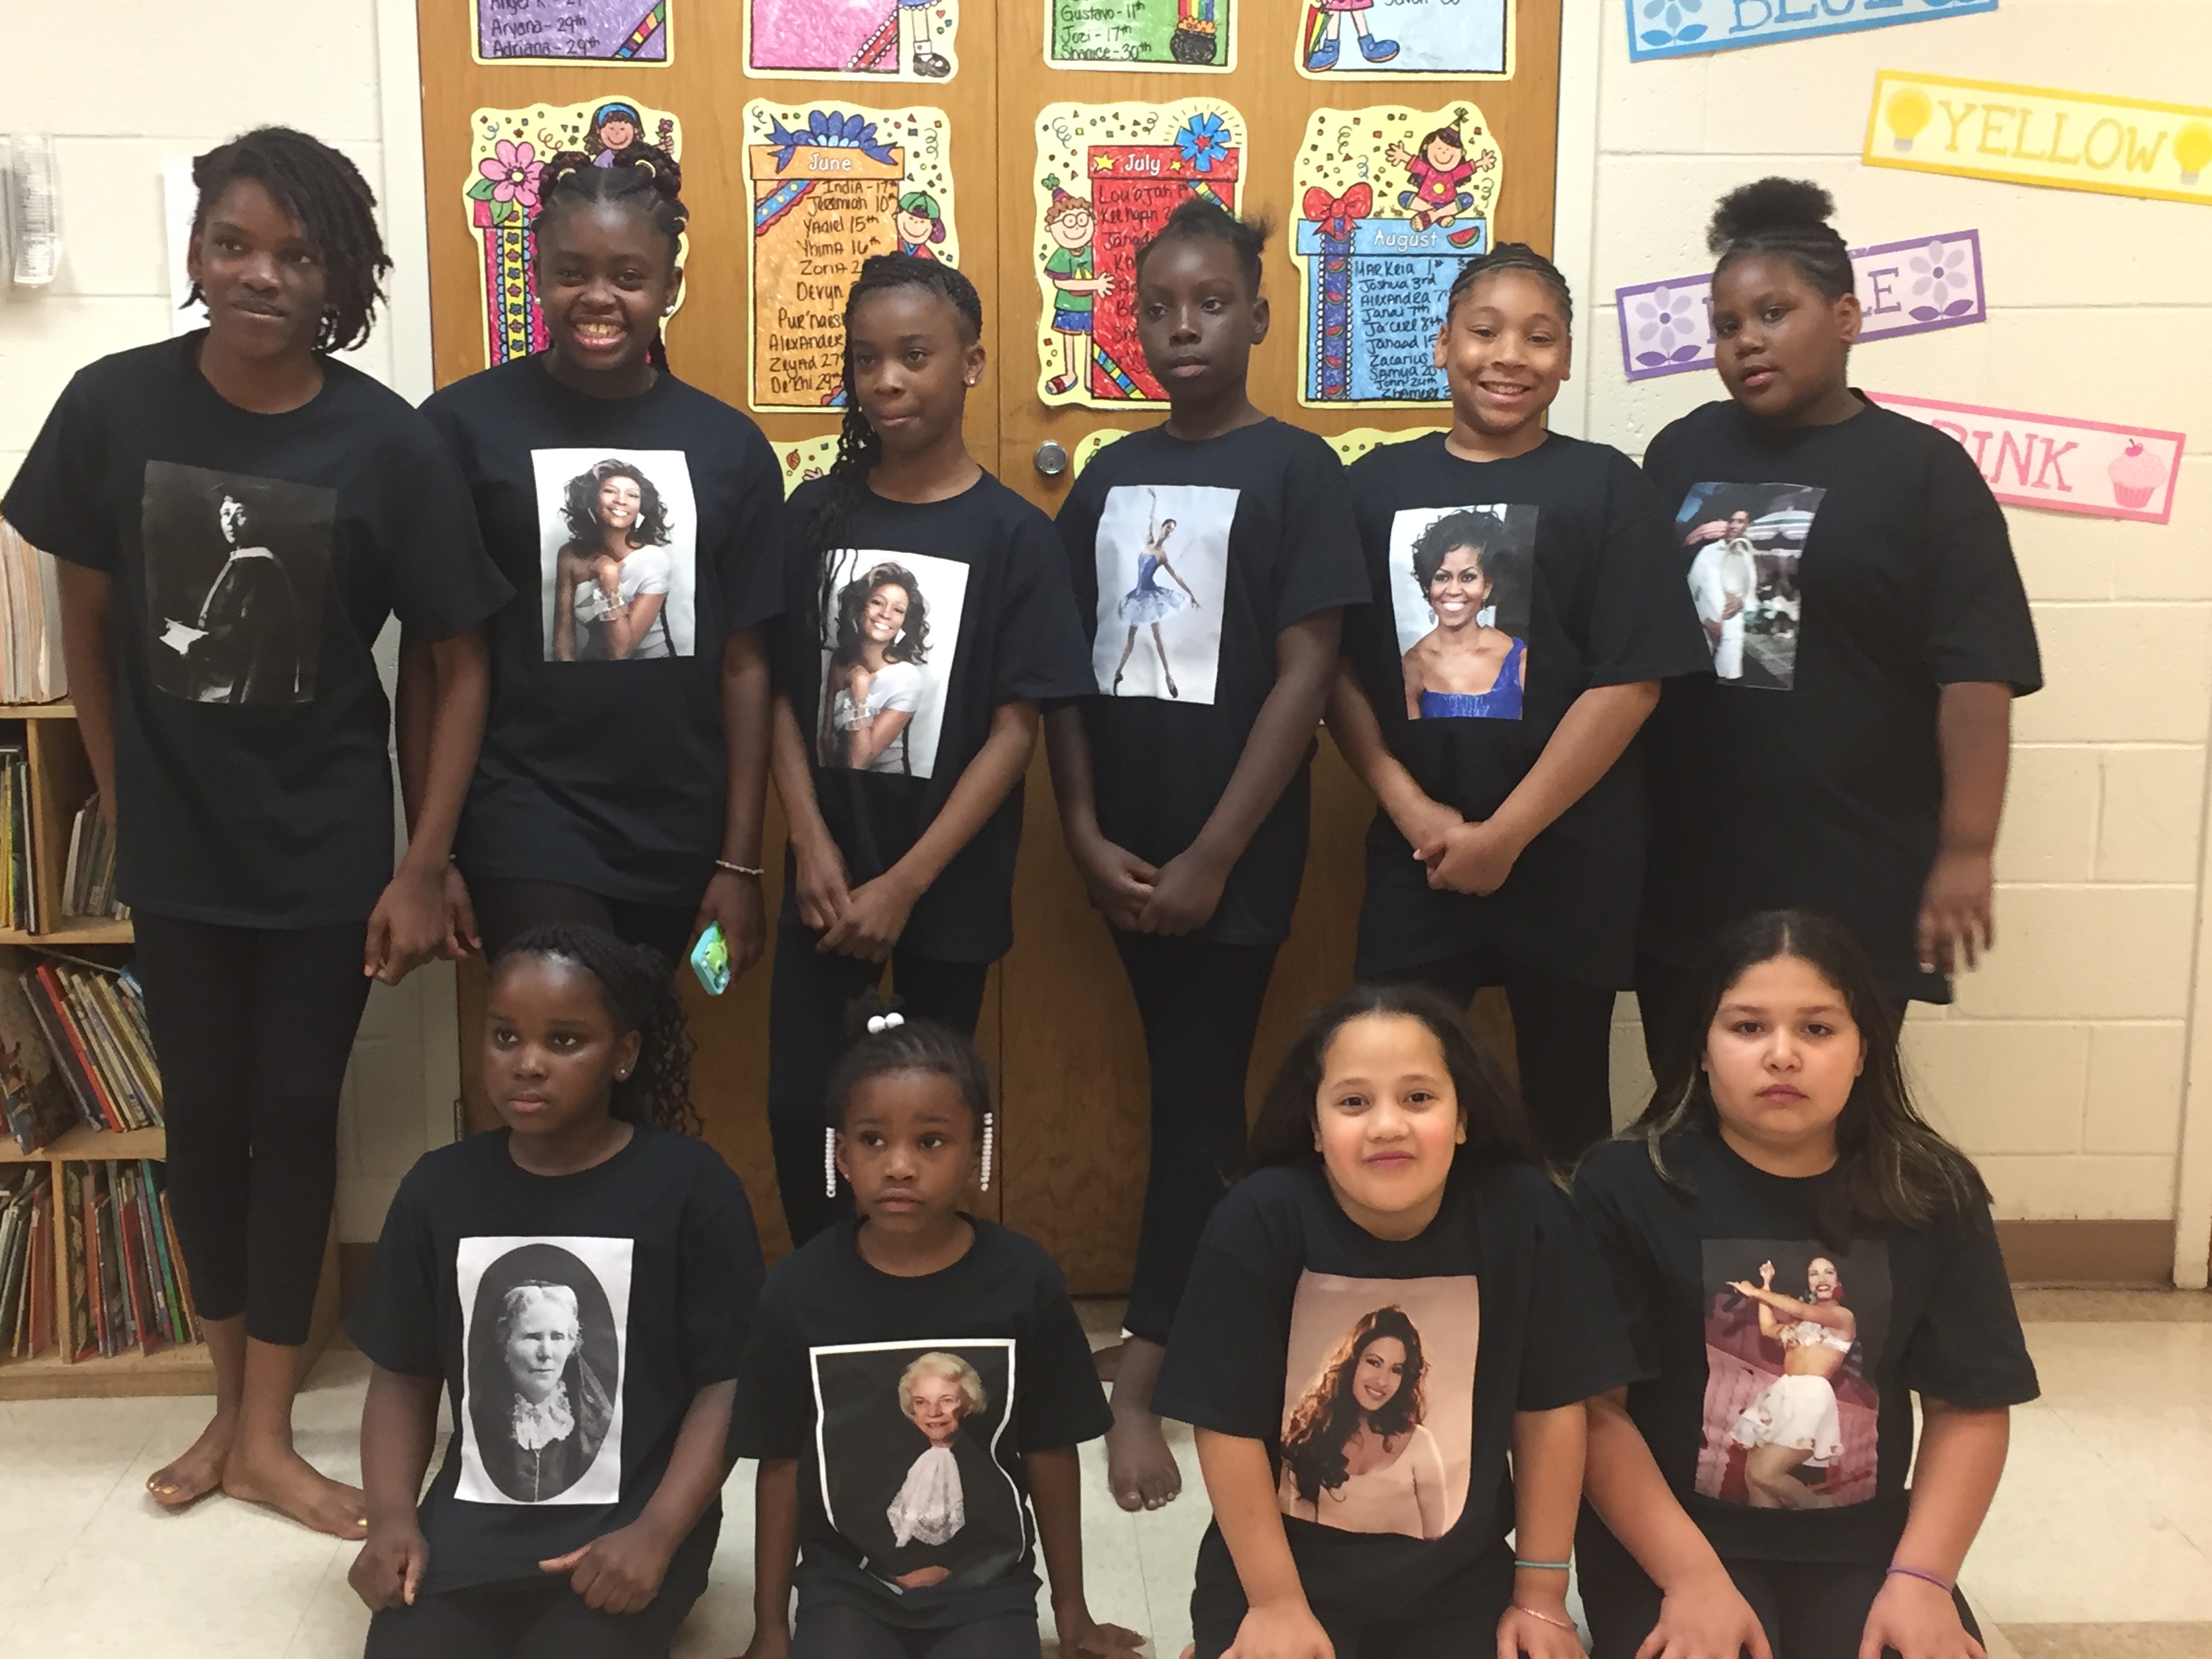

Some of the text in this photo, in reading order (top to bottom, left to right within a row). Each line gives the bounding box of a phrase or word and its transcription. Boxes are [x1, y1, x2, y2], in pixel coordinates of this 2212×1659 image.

[1061, 5, 1115, 22] Gustavo
[491, 18, 543, 39] Aryana
[493, 39, 551, 56] Adriana
[1938, 99, 2168, 173] YELLOW
[808, 153, 853, 171] June
[1125, 153, 1161, 176] July
[1374, 229, 1438, 253] August
[796, 281, 844, 312] Devyn
